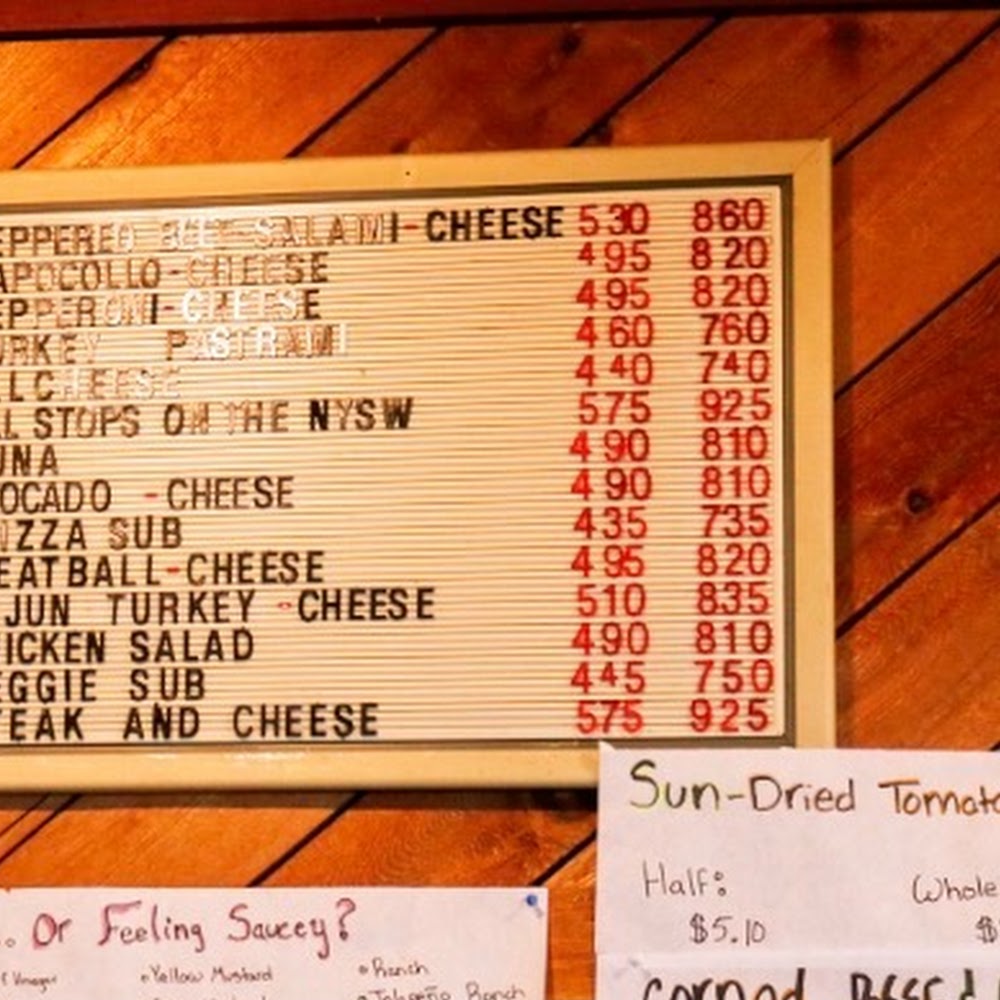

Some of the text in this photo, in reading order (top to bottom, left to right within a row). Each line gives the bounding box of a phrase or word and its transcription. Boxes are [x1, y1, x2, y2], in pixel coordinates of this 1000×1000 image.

[578, 203, 649, 236] 530
[693, 198, 765, 232] 860
[578, 240, 651, 273] 495
[691, 236, 767, 270] 820
[575, 278, 650, 310] 495
[692, 273, 769, 308] 820
[576, 315, 653, 348] 460
[700, 311, 769, 345] 760
[575, 353, 653, 386] 440
[698, 350, 769, 384] 740
[33, 404, 141, 440] STOPS
[309, 396, 414, 431] NYSW
[578, 391, 651, 424] 575
[701, 388, 772, 422] 925
[569, 428, 650, 463] 490
[701, 425, 768, 460] 810
[570, 467, 651, 501] 490
[701, 464, 771, 498] 810
[108, 516, 182, 550] SUB
[573, 506, 647, 540] 435
[700, 503, 769, 538] 735
[571, 544, 644, 577] 495
[698, 542, 770, 576] 820
[106, 589, 257, 626] TURKEY
[577, 583, 646, 617] 510
[698, 581, 769, 615] 835
[129, 628, 255, 663] SALAD
[571, 622, 650, 655] 490
[696, 620, 773, 654] 810
[129, 667, 206, 701] SUB
[571, 661, 645, 694] 445
[694, 659, 774, 693] 750
[123, 704, 200, 740] AND
[233, 703, 379, 738] CHEESE
[576, 699, 643, 733] 575
[690, 698, 768, 732] 925
[628, 758, 857, 813] Sun-Dried
[641, 859, 728, 899] Half:
[32, 896, 357, 960] Or Feeling Saucey?
[689, 912, 767, 947] $5.10
[149, 964, 203, 984] Yellow
[372, 957, 429, 978] Ranch
